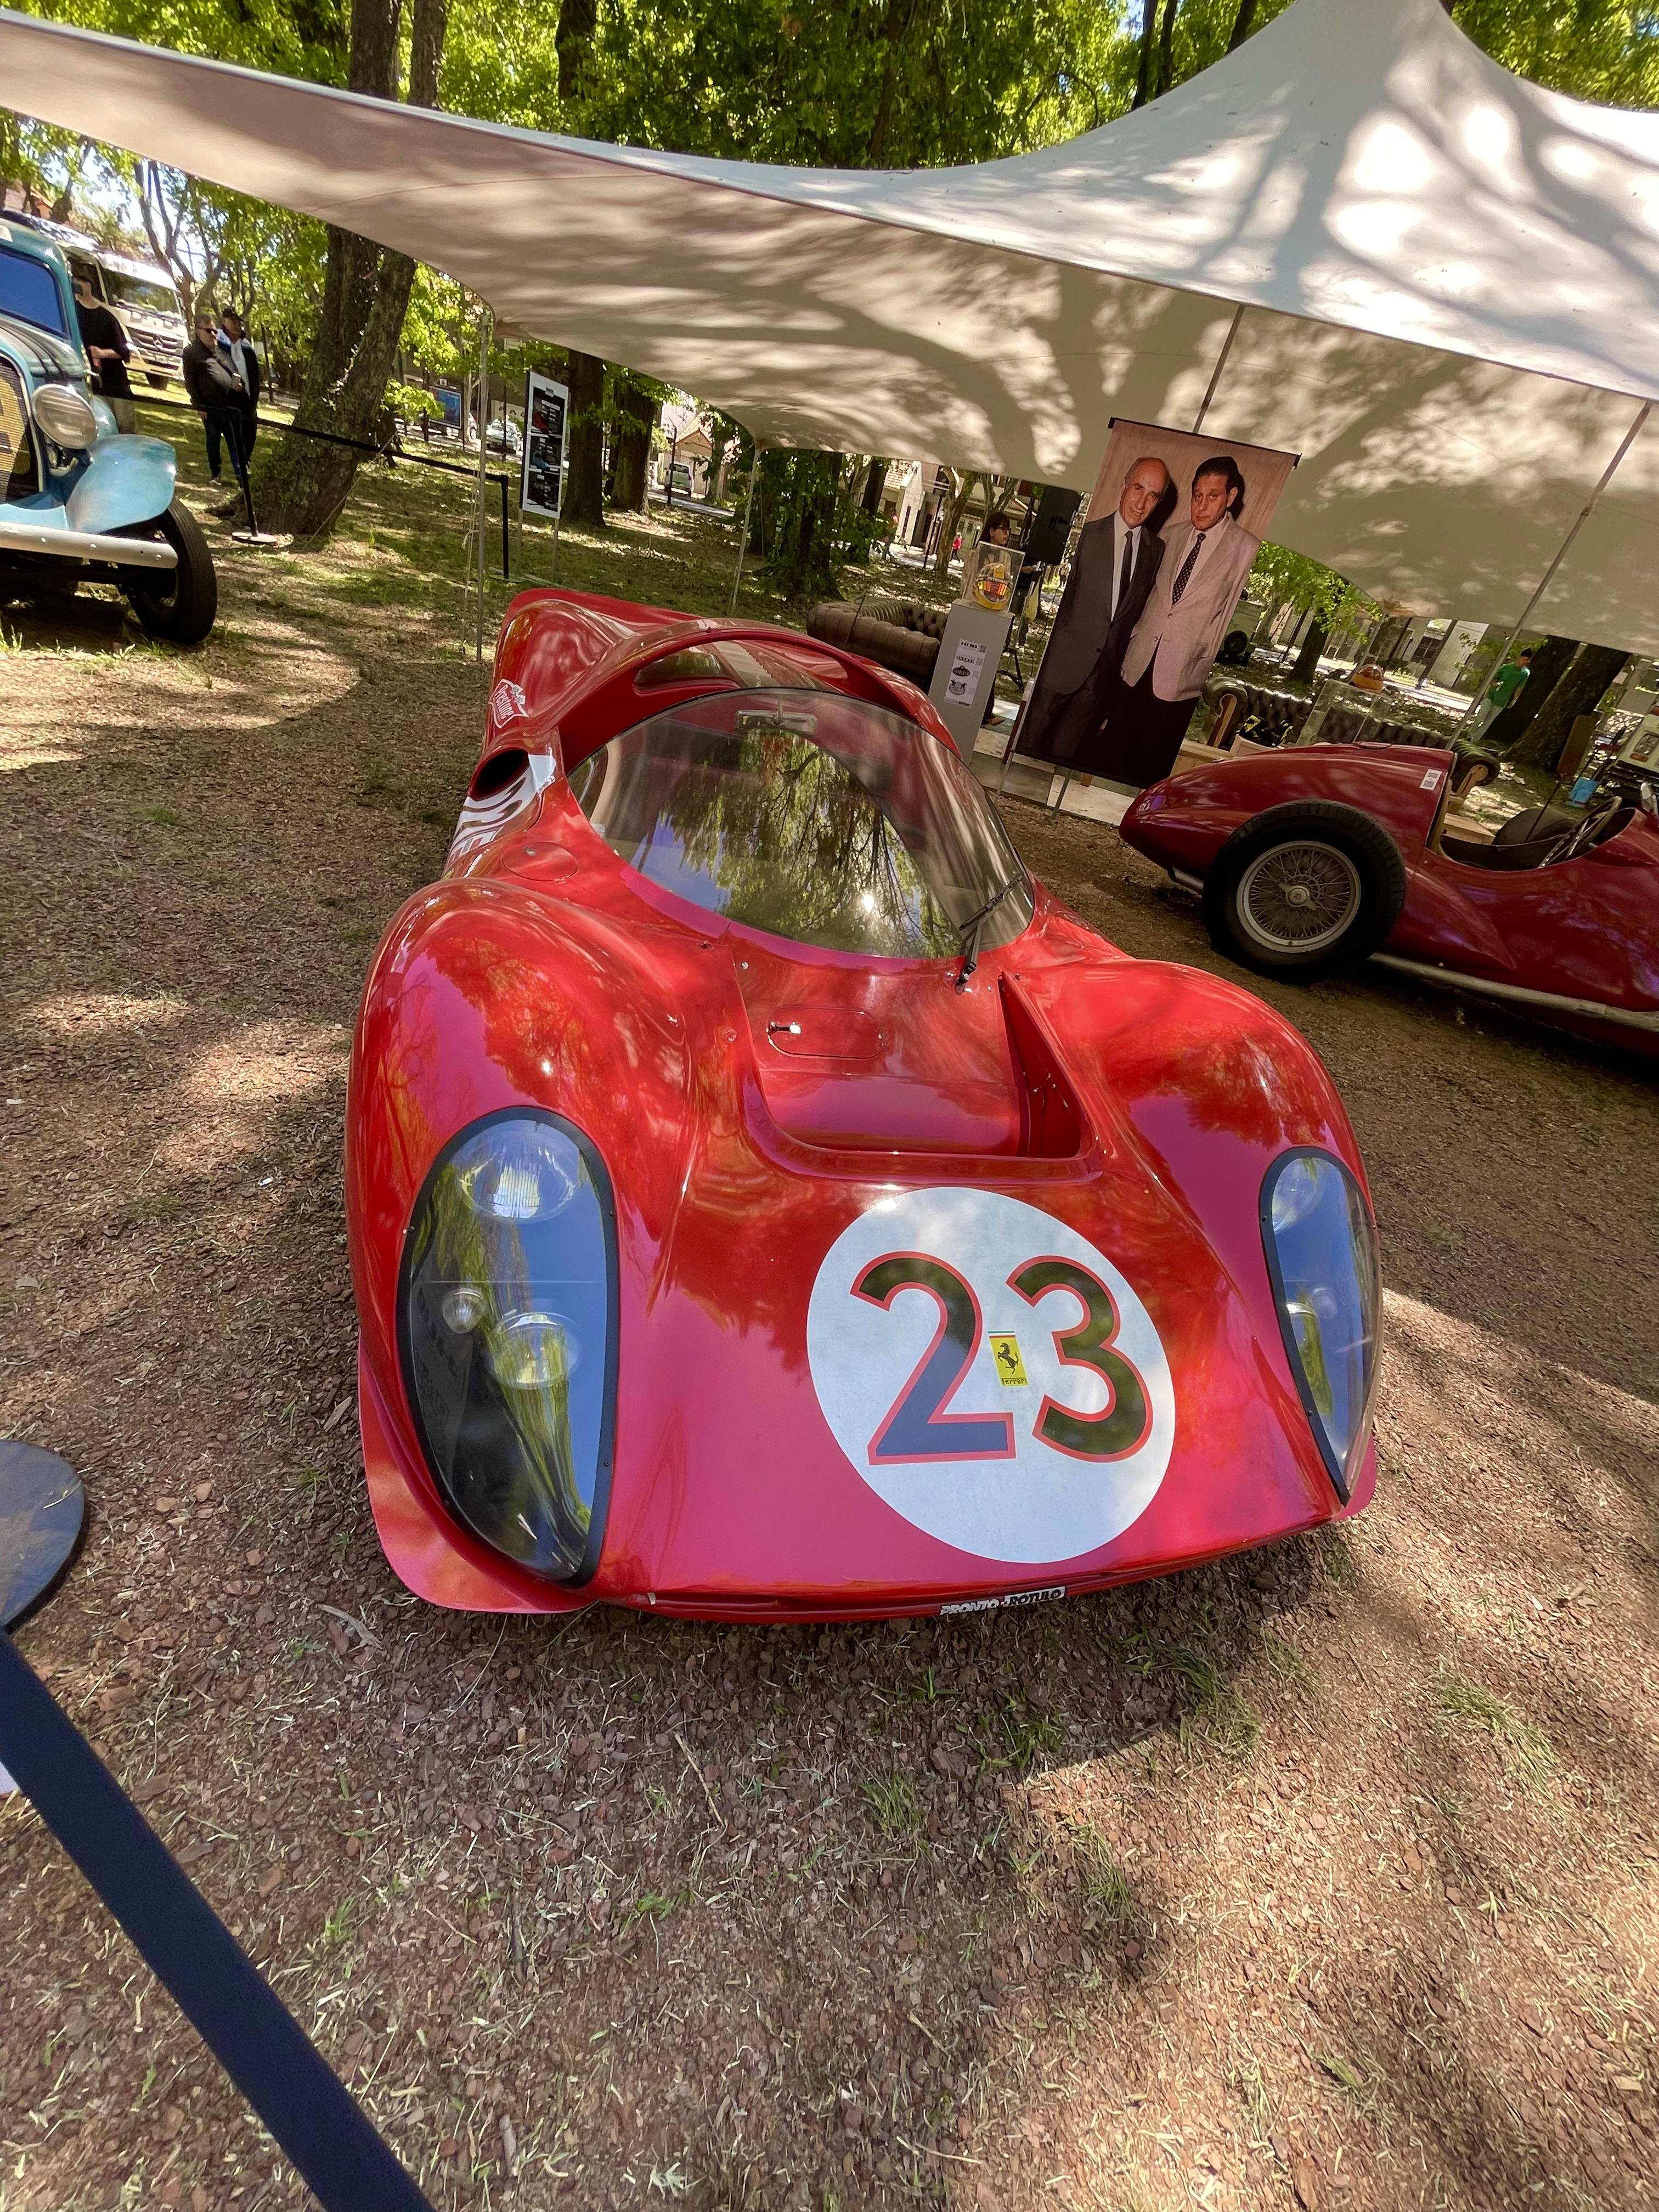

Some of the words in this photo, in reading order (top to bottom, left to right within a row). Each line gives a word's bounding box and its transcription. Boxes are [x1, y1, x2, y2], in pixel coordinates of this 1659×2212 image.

[494, 684, 514, 719] Prestone
[850, 1250, 1153, 1465] 23
[939, 1599, 1000, 1615] PRONTO
